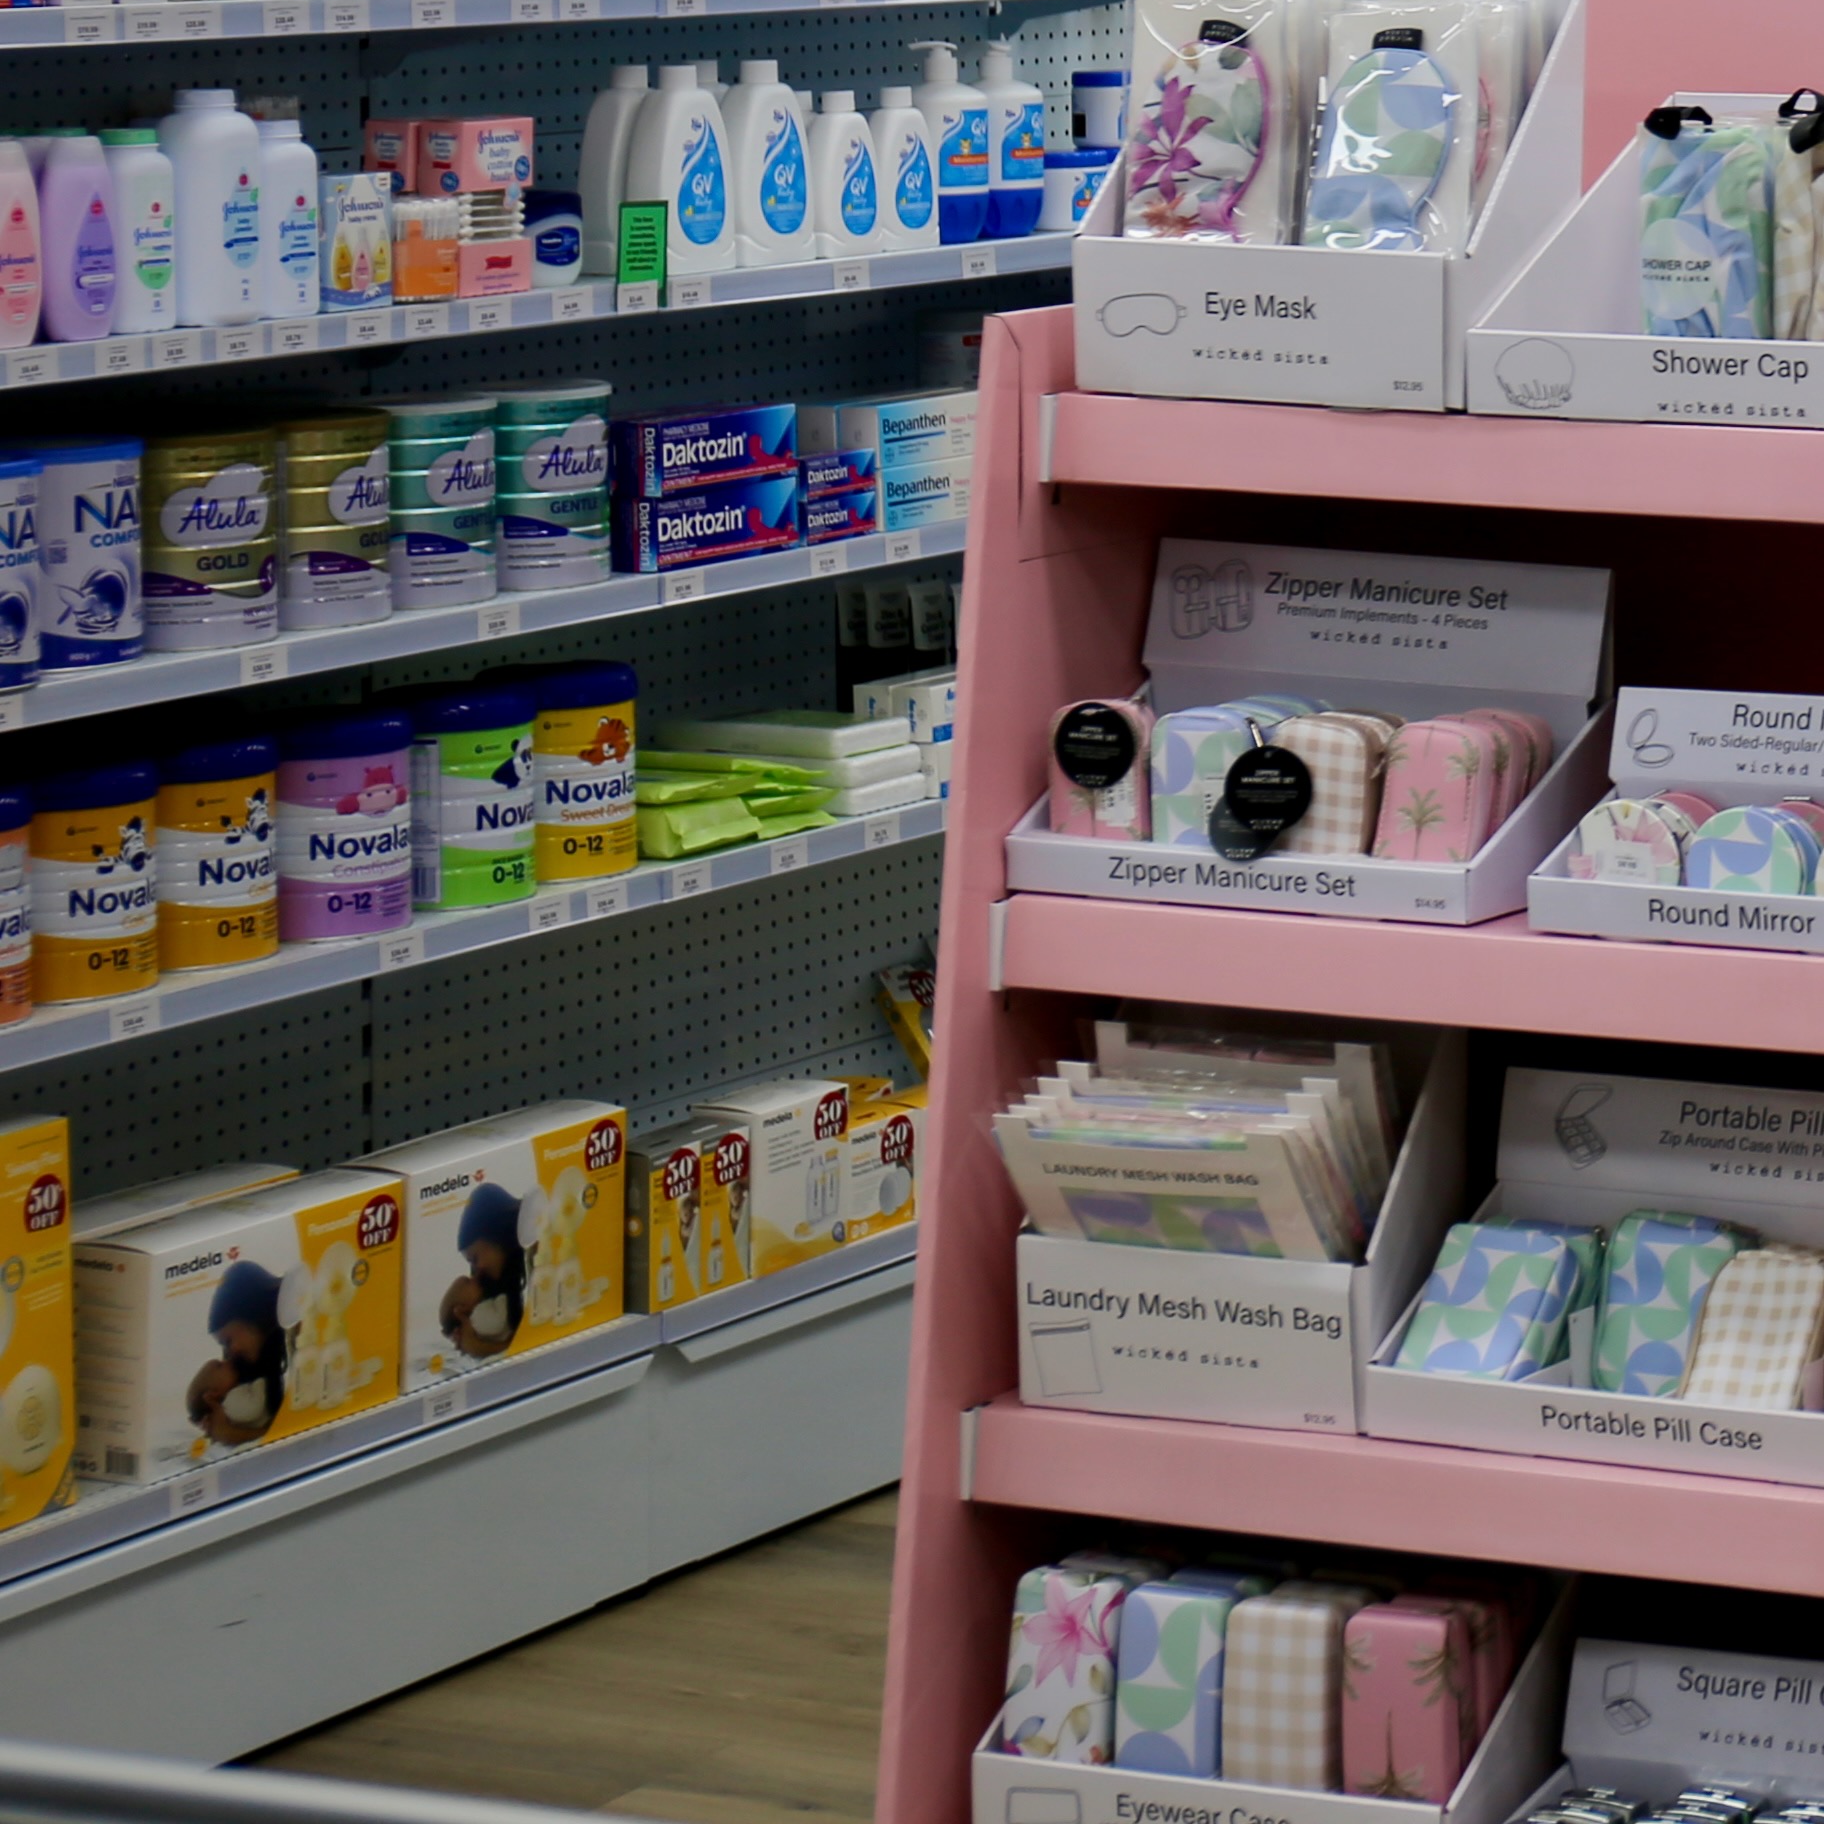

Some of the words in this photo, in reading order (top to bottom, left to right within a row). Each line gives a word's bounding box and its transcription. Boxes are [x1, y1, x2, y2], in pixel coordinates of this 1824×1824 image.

[1685, 260, 1711, 271] CAP
[1204, 291, 1246, 322] Eye
[1254, 292, 1318, 321] Mask
[1273, 349, 1330, 366] sista
[1651, 347, 1751, 379] Shower
[1758, 352, 1809, 384] Cap
[882, 412, 946, 435] Bepanthen
[1746, 405, 1806, 419] sista
[538, 444, 603, 479] Alula
[662, 433, 744, 468] Daktozin
[807, 466, 848, 484] Daktozin
[886, 475, 950, 497] Bepanthen
[177, 496, 260, 535] Alula
[550, 499, 599, 515] GENTLE
[657, 507, 743, 542] Daktozin
[196, 552, 249, 572] GOLD
[1264, 571, 1343, 602] Zipper
[1349, 576, 1460, 609] Manicure
[1468, 586, 1508, 612] Set
[1277, 602, 1336, 621] Premium
[1339, 606, 1418, 627] Implements
[1431, 614, 1438, 626] 4
[1444, 612, 1488, 631] Pieces
[1732, 704, 1812, 731] Round
[1689, 732, 1717, 746] Two
[1108, 855, 1187, 888] Zipper
[1194, 863, 1308, 895] Manicure
[1315, 870, 1356, 898] Set
[327, 891, 372, 915] 0-12
[1648, 898, 1730, 928] Round
[1738, 905, 1816, 934] Mirror
[217, 916, 255, 938] 0-12
[88, 947, 130, 971] 0-12
[1678, 1100, 1783, 1134] Portable
[1658, 1129, 1682, 1149] Zip
[1685, 1133, 1736, 1152] Around
[1738, 1136, 1773, 1154] Case
[1777, 1140, 1808, 1156] With
[420, 1172, 470, 1201] medela
[1042, 1162, 1119, 1180] LAUNDRY
[1122, 1167, 1168, 1182] MESH
[1170, 1170, 1220, 1184] WASH
[1223, 1173, 1260, 1186] BAG
[30, 1211, 58, 1230] OFF
[165, 1251, 223, 1280] medela
[1026, 1282, 1130, 1318] Laundry
[1138, 1291, 1206, 1321] Mesh
[1214, 1299, 1284, 1329] Wash
[1293, 1307, 1343, 1339] Bag
[1540, 1405, 1646, 1439] Portable
[1654, 1414, 1692, 1443] Pill
[1698, 1421, 1763, 1451] Case
[1676, 1664, 1765, 1704] Square
[1771, 1673, 1813, 1705] Pill
[1116, 1794, 1221, 1824] Eyewear
